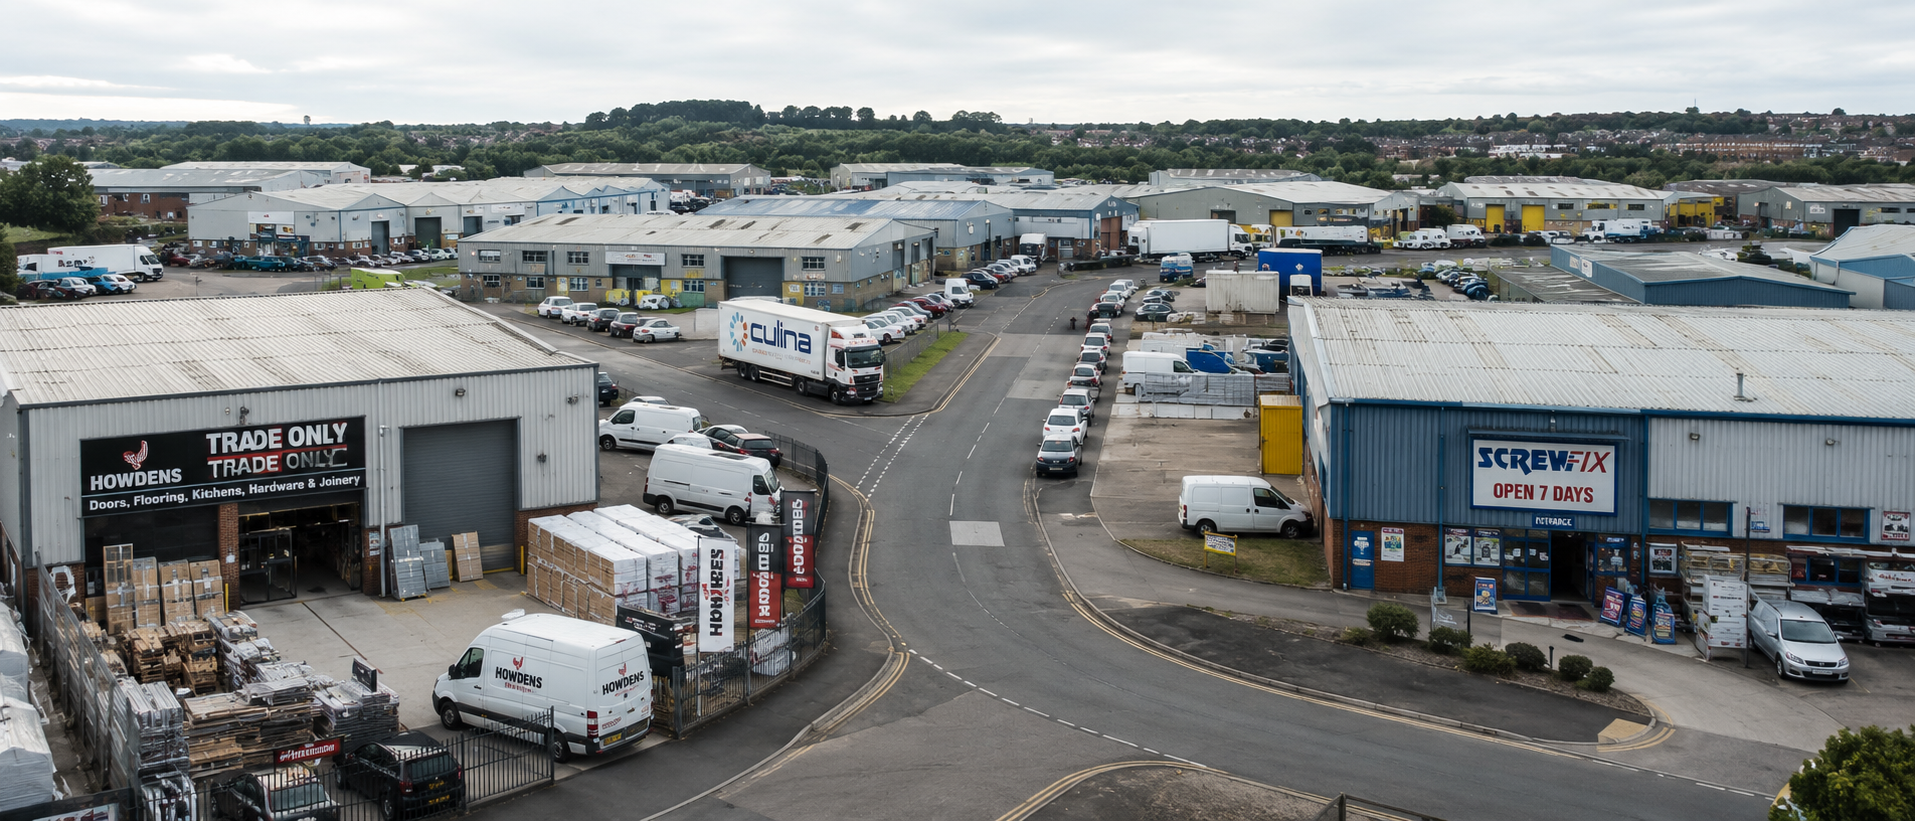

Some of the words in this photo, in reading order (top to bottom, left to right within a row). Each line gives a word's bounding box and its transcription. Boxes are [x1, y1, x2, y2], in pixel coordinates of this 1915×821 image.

[750, 319, 812, 355] culina
[206, 428, 283, 455] TRADE
[287, 422, 348, 447] ONLY
[207, 454, 279, 479] TRADE
[1477, 447, 1611, 476] SCREWFIX
[90, 468, 182, 491] HOWDENS
[89, 499, 131, 511] Doors,
[133, 492, 189, 507] Flooring,
[248, 480, 305, 494] Hardware
[307, 478, 316, 489] &
[319, 475, 361, 487] Joinery
[1493, 482, 1535, 501] OPEN
[1539, 485, 1549, 501] 7
[1553, 485, 1594, 504] DAYS
[495, 666, 543, 689] HOWDENS
[602, 670, 645, 696] HOWDENS
